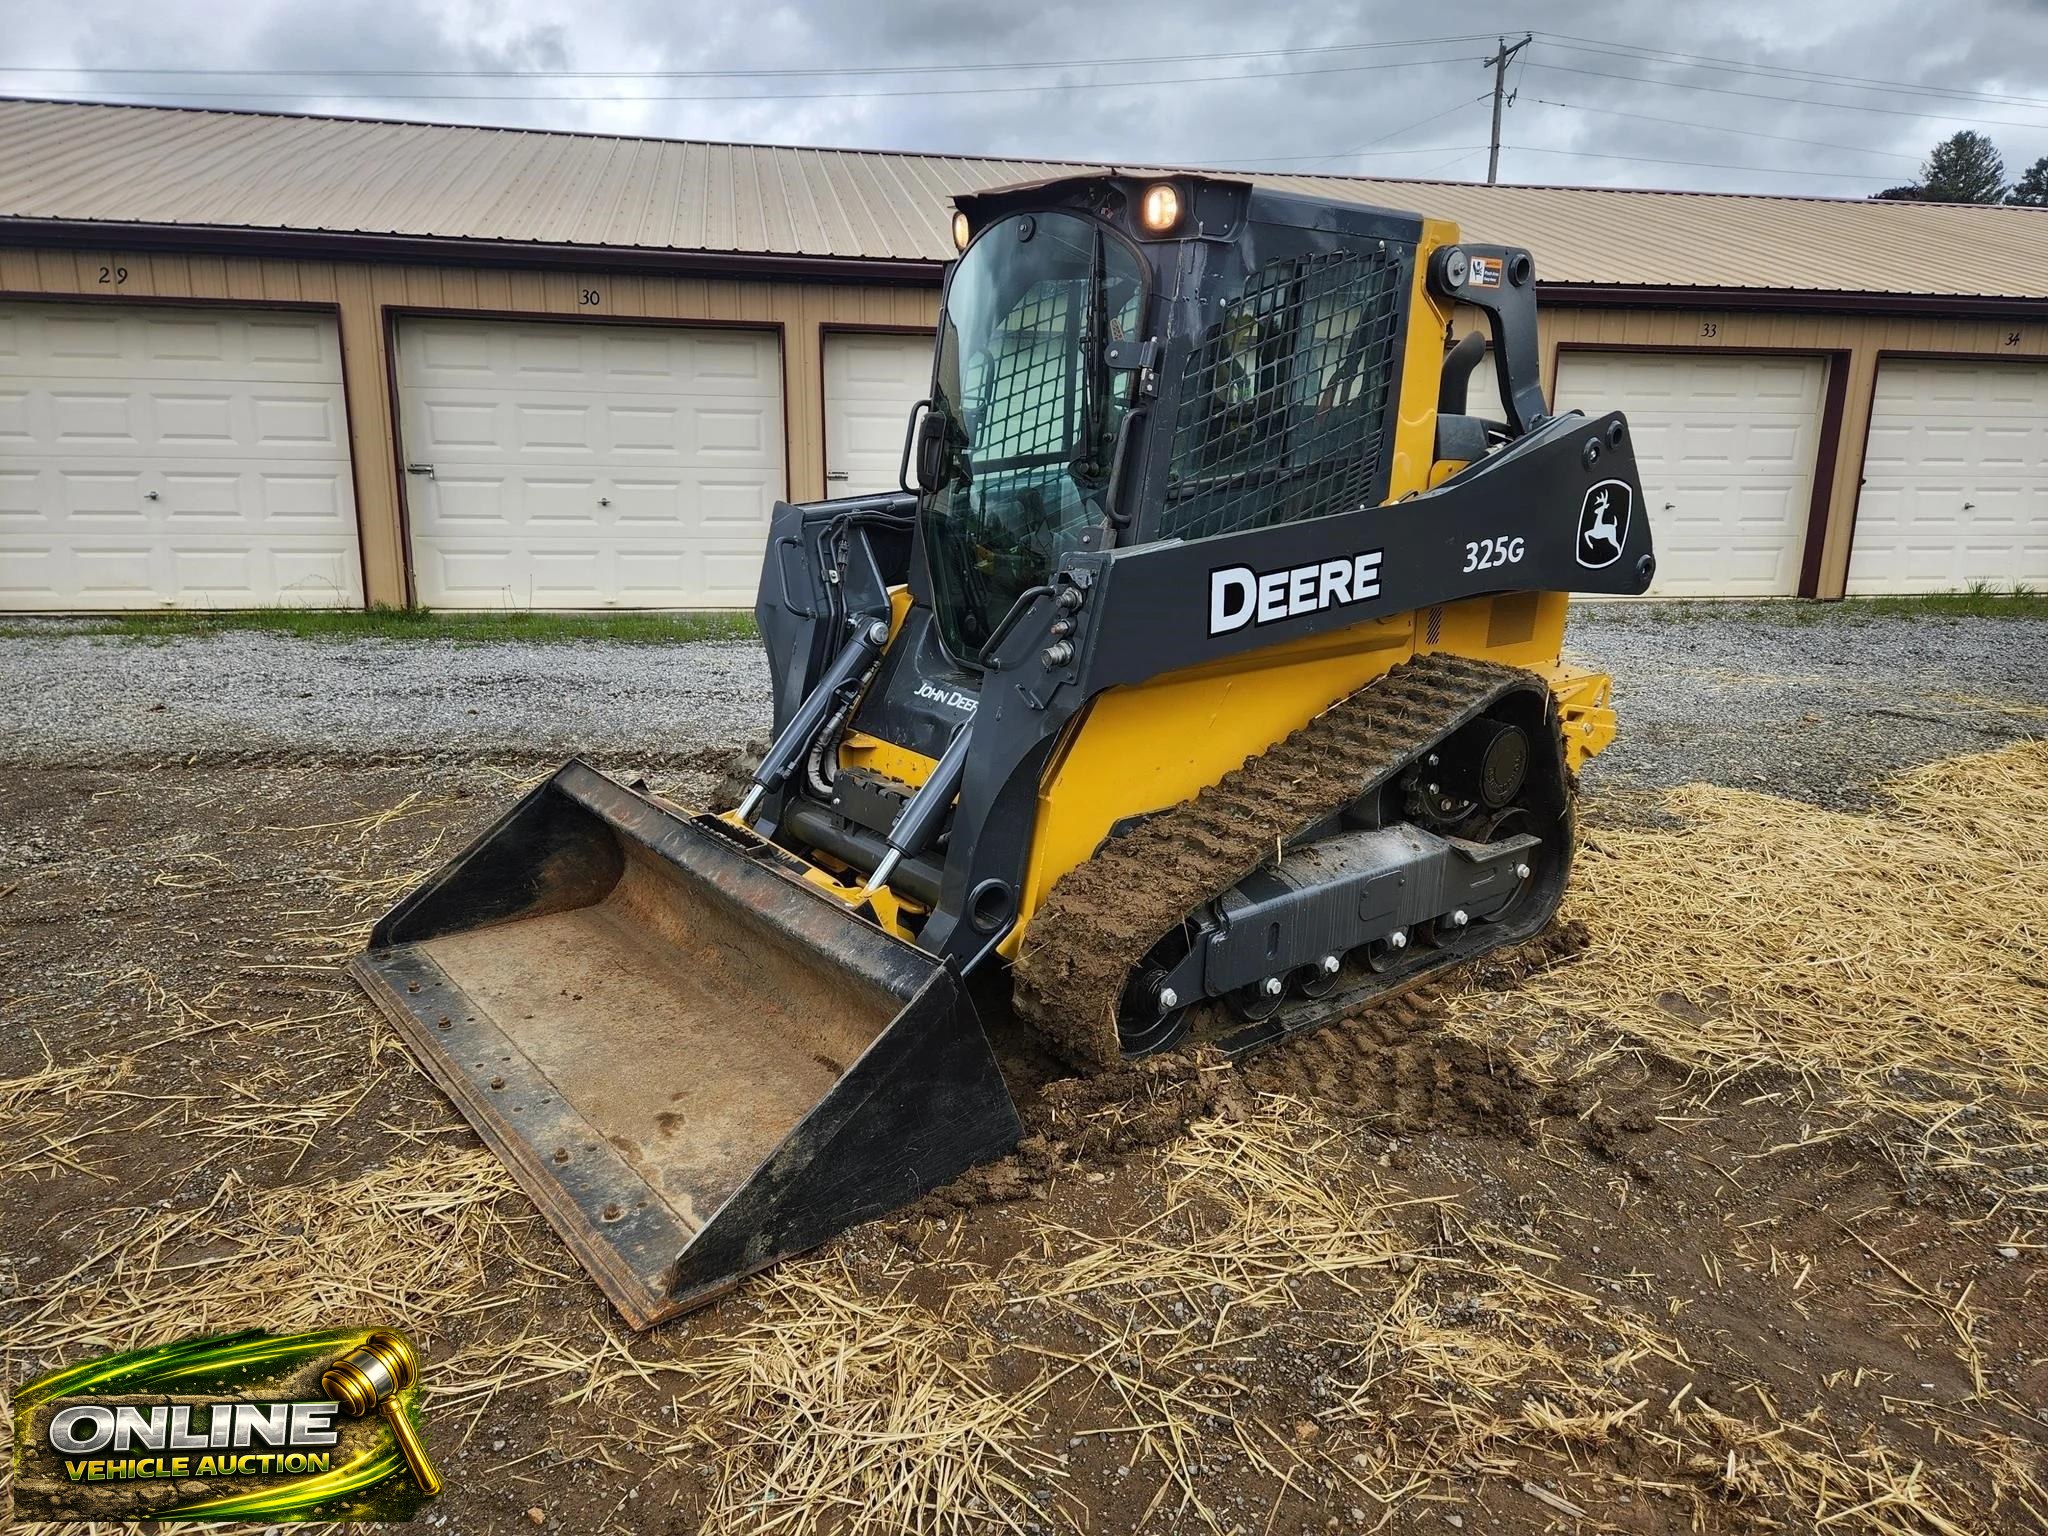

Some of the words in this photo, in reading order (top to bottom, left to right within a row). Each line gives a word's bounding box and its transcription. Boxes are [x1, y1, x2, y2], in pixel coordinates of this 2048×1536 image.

[99, 266, 128, 284] 29
[578, 289, 600, 305] 30
[1700, 322, 1717, 338] 33
[2004, 332, 2020, 346] 34
[1462, 535, 1525, 573] 325G
[1209, 550, 1384, 636] DEERE
[913, 682, 949, 703] JOHN
